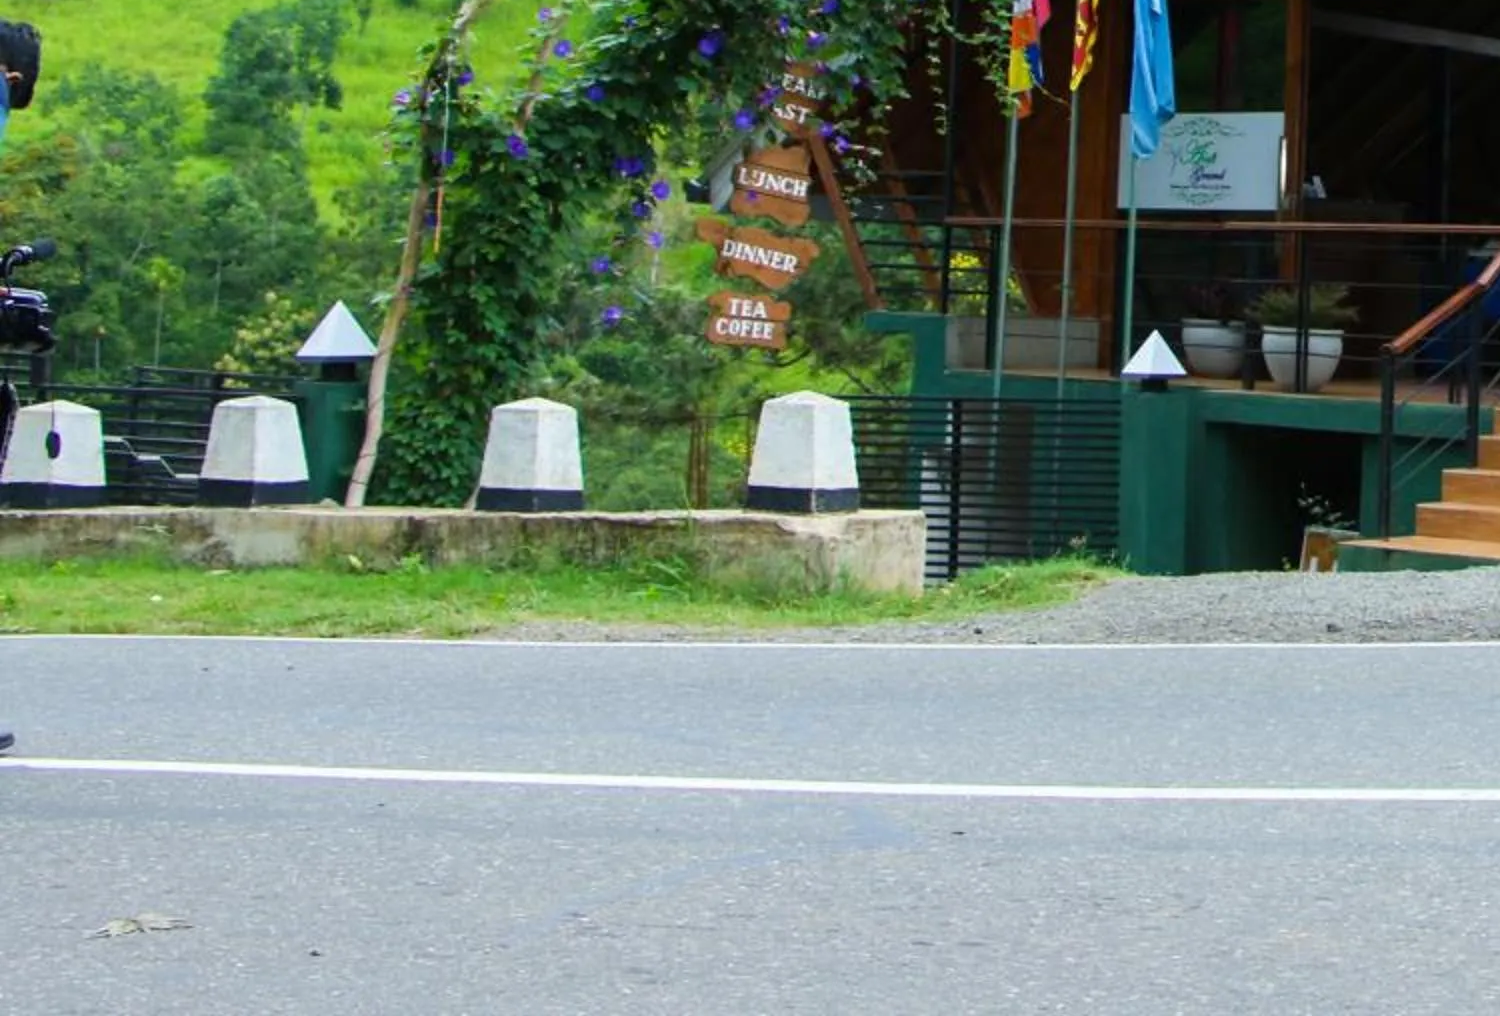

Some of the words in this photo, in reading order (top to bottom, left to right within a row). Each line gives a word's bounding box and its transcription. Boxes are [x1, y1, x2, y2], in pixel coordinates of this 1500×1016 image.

[739, 167, 808, 197] LUNCH
[722, 239, 797, 273] DINNER
[729, 299, 766, 319] TEA
